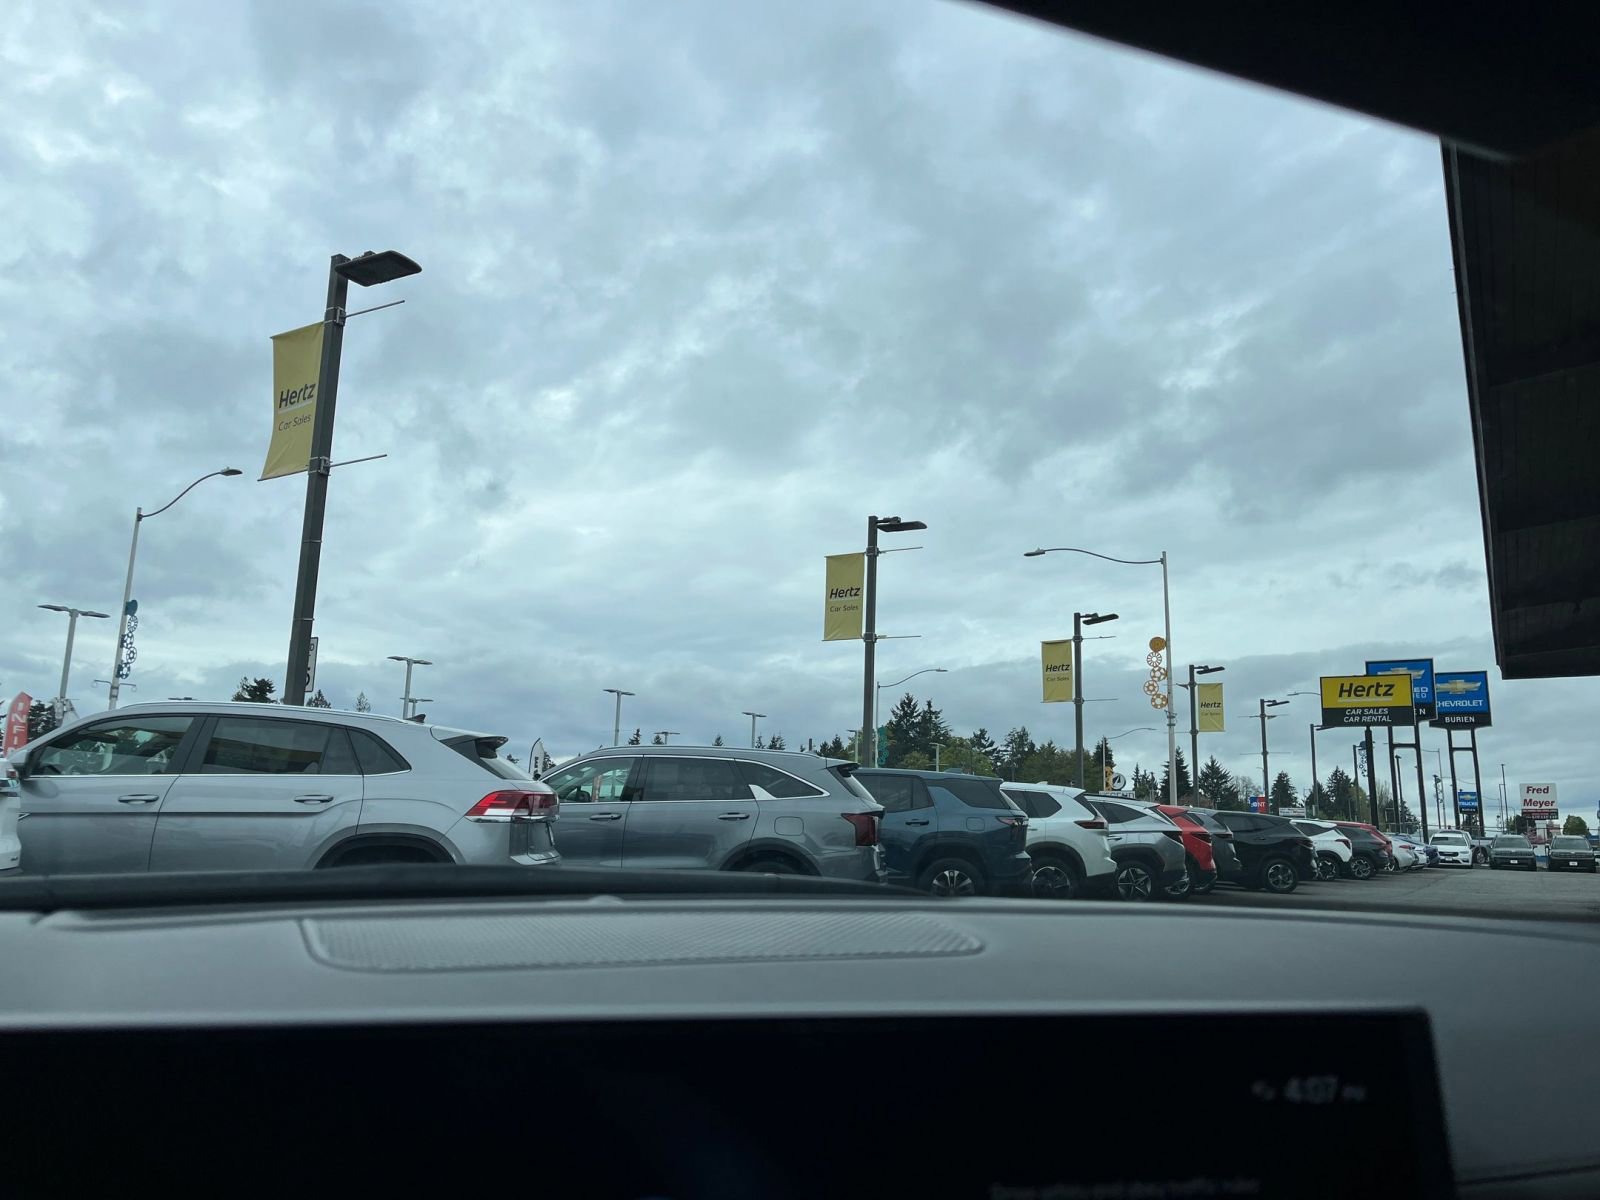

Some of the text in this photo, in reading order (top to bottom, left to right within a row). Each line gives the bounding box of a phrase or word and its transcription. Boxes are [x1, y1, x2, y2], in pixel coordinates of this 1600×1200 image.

[279, 383, 316, 409] Hertz
[278, 414, 312, 431] Car Sales
[830, 587, 861, 599] Hertz
[843, 604, 859, 612] Sales
[1045, 663, 1070, 672] Hertz
[1338, 682, 1396, 698] Hertz
[1200, 701, 1222, 709] Hertz
[1436, 699, 1484, 708] HEVROLET
[9, 702, 26, 749] INFI
[1526, 786, 1550, 794] Fred
[1523, 798, 1555, 808] Meyer
